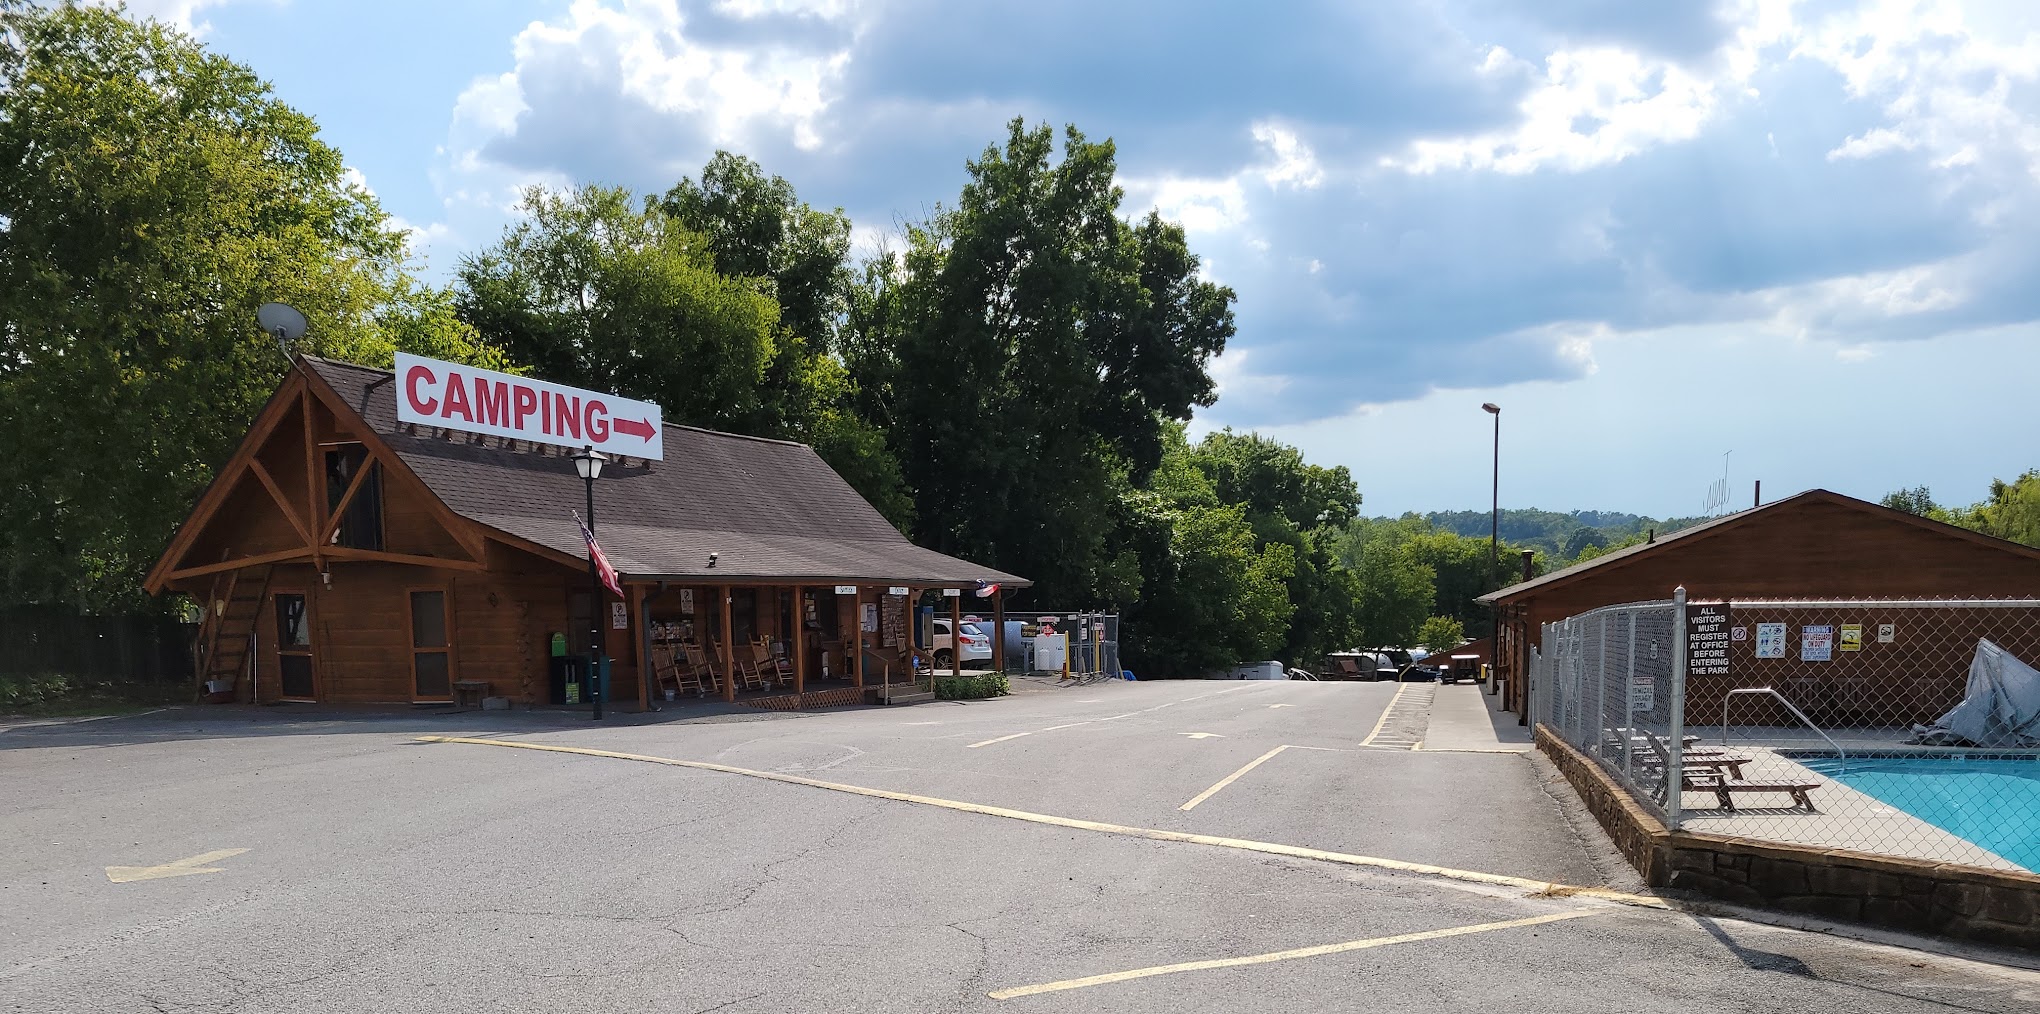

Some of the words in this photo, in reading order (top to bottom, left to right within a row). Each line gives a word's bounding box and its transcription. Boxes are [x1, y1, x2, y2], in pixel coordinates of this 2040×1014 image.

[405, 365, 609, 443] CAMPING
[1700, 607, 1715, 615] ALL
[1691, 615, 1725, 624] VISITORS
[1698, 624, 1719, 632] MUST
[1690, 633, 1728, 641] REGISTER
[1690, 641, 1700, 650] AT
[1701, 641, 1728, 649] OFFICE
[1694, 650, 1725, 658] BEFORE
[1690, 658, 1729, 667] ENTERING
[1691, 667, 1706, 675] THE
[1707, 666, 1729, 674] PARK
